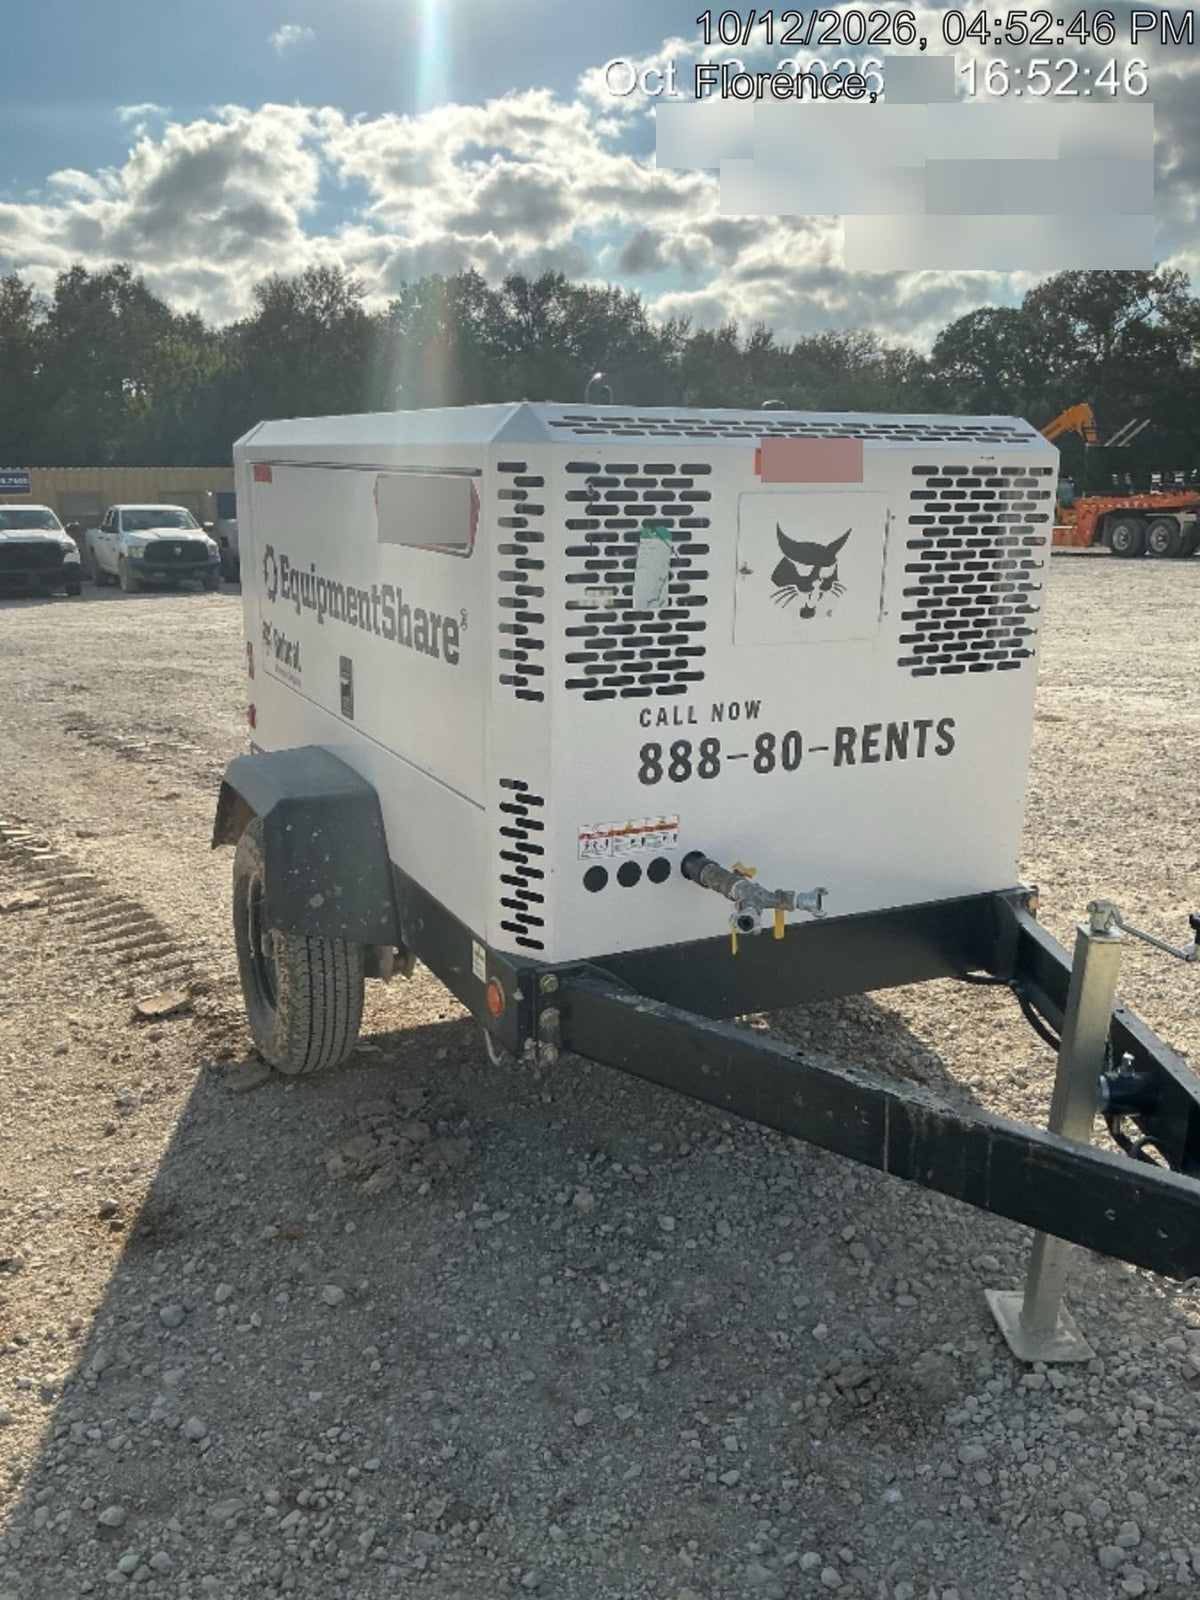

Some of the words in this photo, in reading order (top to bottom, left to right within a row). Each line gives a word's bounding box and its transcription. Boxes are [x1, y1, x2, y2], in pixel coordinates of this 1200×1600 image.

[279, 553, 460, 666] EquipmentShare
[639, 704, 698, 728] CALL
[711, 699, 762, 723] NOW
[638, 716, 956, 786] 888-80-RENTS
